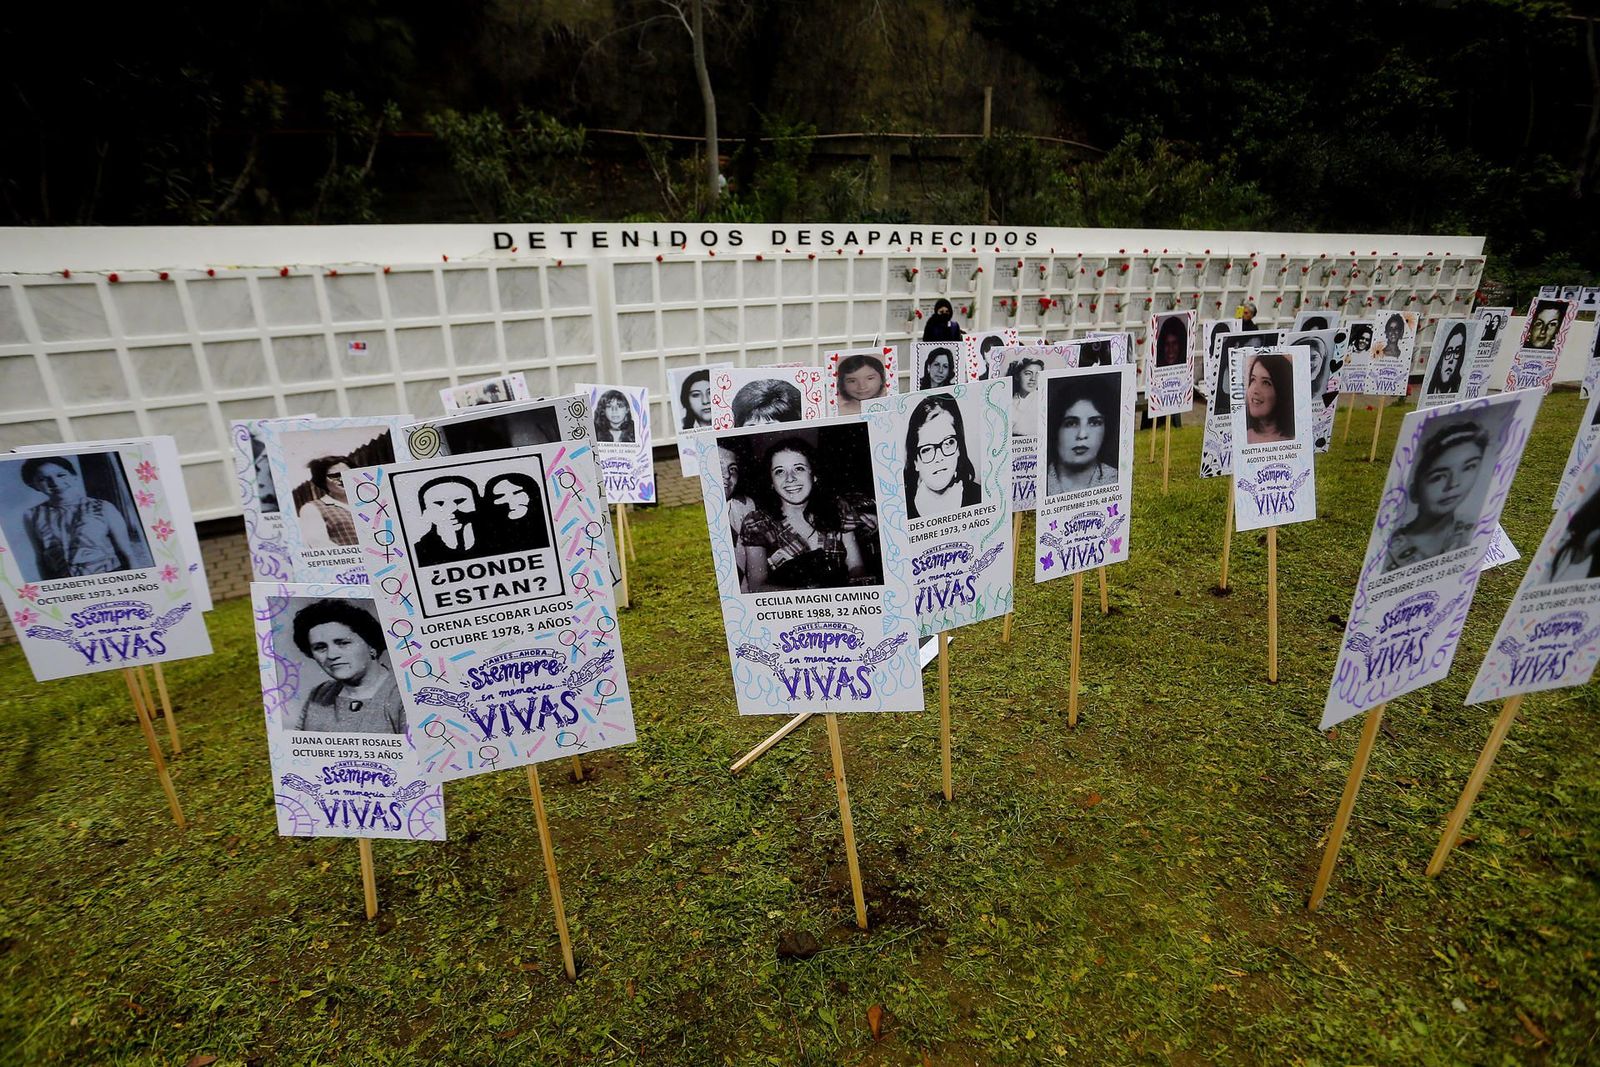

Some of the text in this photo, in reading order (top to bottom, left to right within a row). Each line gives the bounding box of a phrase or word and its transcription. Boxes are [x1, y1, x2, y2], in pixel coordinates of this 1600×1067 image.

[493, 230, 1038, 249] DETENIDOS DESAPARECIDOS
[1247, 456, 1265, 464] AGOSTO
[1045, 485, 1120, 505] LILA VALDENEGRO CARRASCO
[1053, 502, 1085, 514] SEPTIEMBRE
[1108, 493, 1123, 502] AÑOS
[1255, 491, 1295, 516] VIVAS
[926, 511, 972, 528] CORREDERA
[974, 505, 997, 516] REYES
[940, 525, 961, 537] 1973,
[962, 523, 967, 531] 9
[968, 518, 990, 529] AÑOS
[301, 550, 325, 558] HILDA
[307, 557, 355, 568] SEPTIEMBRE
[912, 550, 969, 575] Siempre
[1060, 540, 1105, 571] VIVAS
[430, 553, 545, 586] ¿DONDE
[41, 572, 147, 592] ELIZABETH LEONIDAS
[434, 576, 548, 608] ESTAN?
[37, 583, 160, 606] OCTUBRE 1973, 14 AÑOS
[755, 591, 880, 607] CECILIA MAGNI CAMINO
[71, 608, 147, 628] Siempre
[420, 600, 574, 636] LORENA ESCOBAR LAGOS
[757, 605, 882, 621] OCTUBRE 1988, 32 AÑOS
[429, 615, 571, 650] OCTUBRE 1978, 3 AÑOS
[780, 632, 858, 653] Siempre
[80, 630, 167, 665] VIVAS
[1366, 632, 1430, 682] VIVAS
[468, 659, 559, 690] Siempre
[1510, 650, 1574, 686] VIVAS
[779, 665, 872, 701] VIVAS
[469, 690, 579, 741] VIVAS
[291, 737, 402, 748] JUANA OLEART ROSALES
[292, 749, 404, 760] OCTUBRE 1973, 53 AÑOS
[322, 766, 391, 788] Siempre
[320, 799, 402, 831] VIVAS
